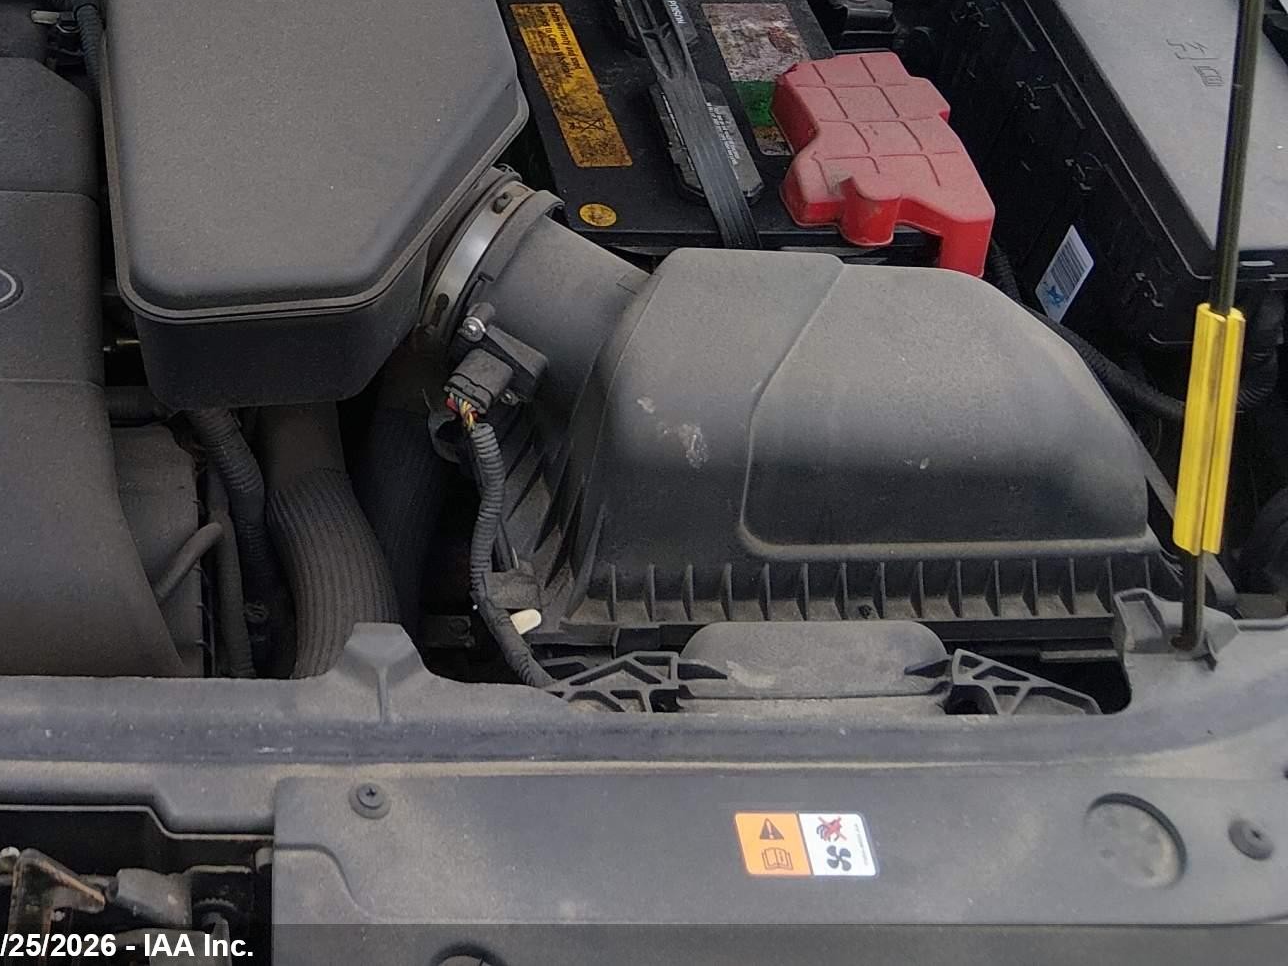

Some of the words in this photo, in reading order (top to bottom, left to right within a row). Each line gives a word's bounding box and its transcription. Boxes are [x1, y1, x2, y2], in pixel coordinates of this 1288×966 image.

[668, 0, 687, 24] POISON
[556, 22, 571, 46] warranty
[566, 46, 579, 56] and
[570, 57, 585, 70] used
